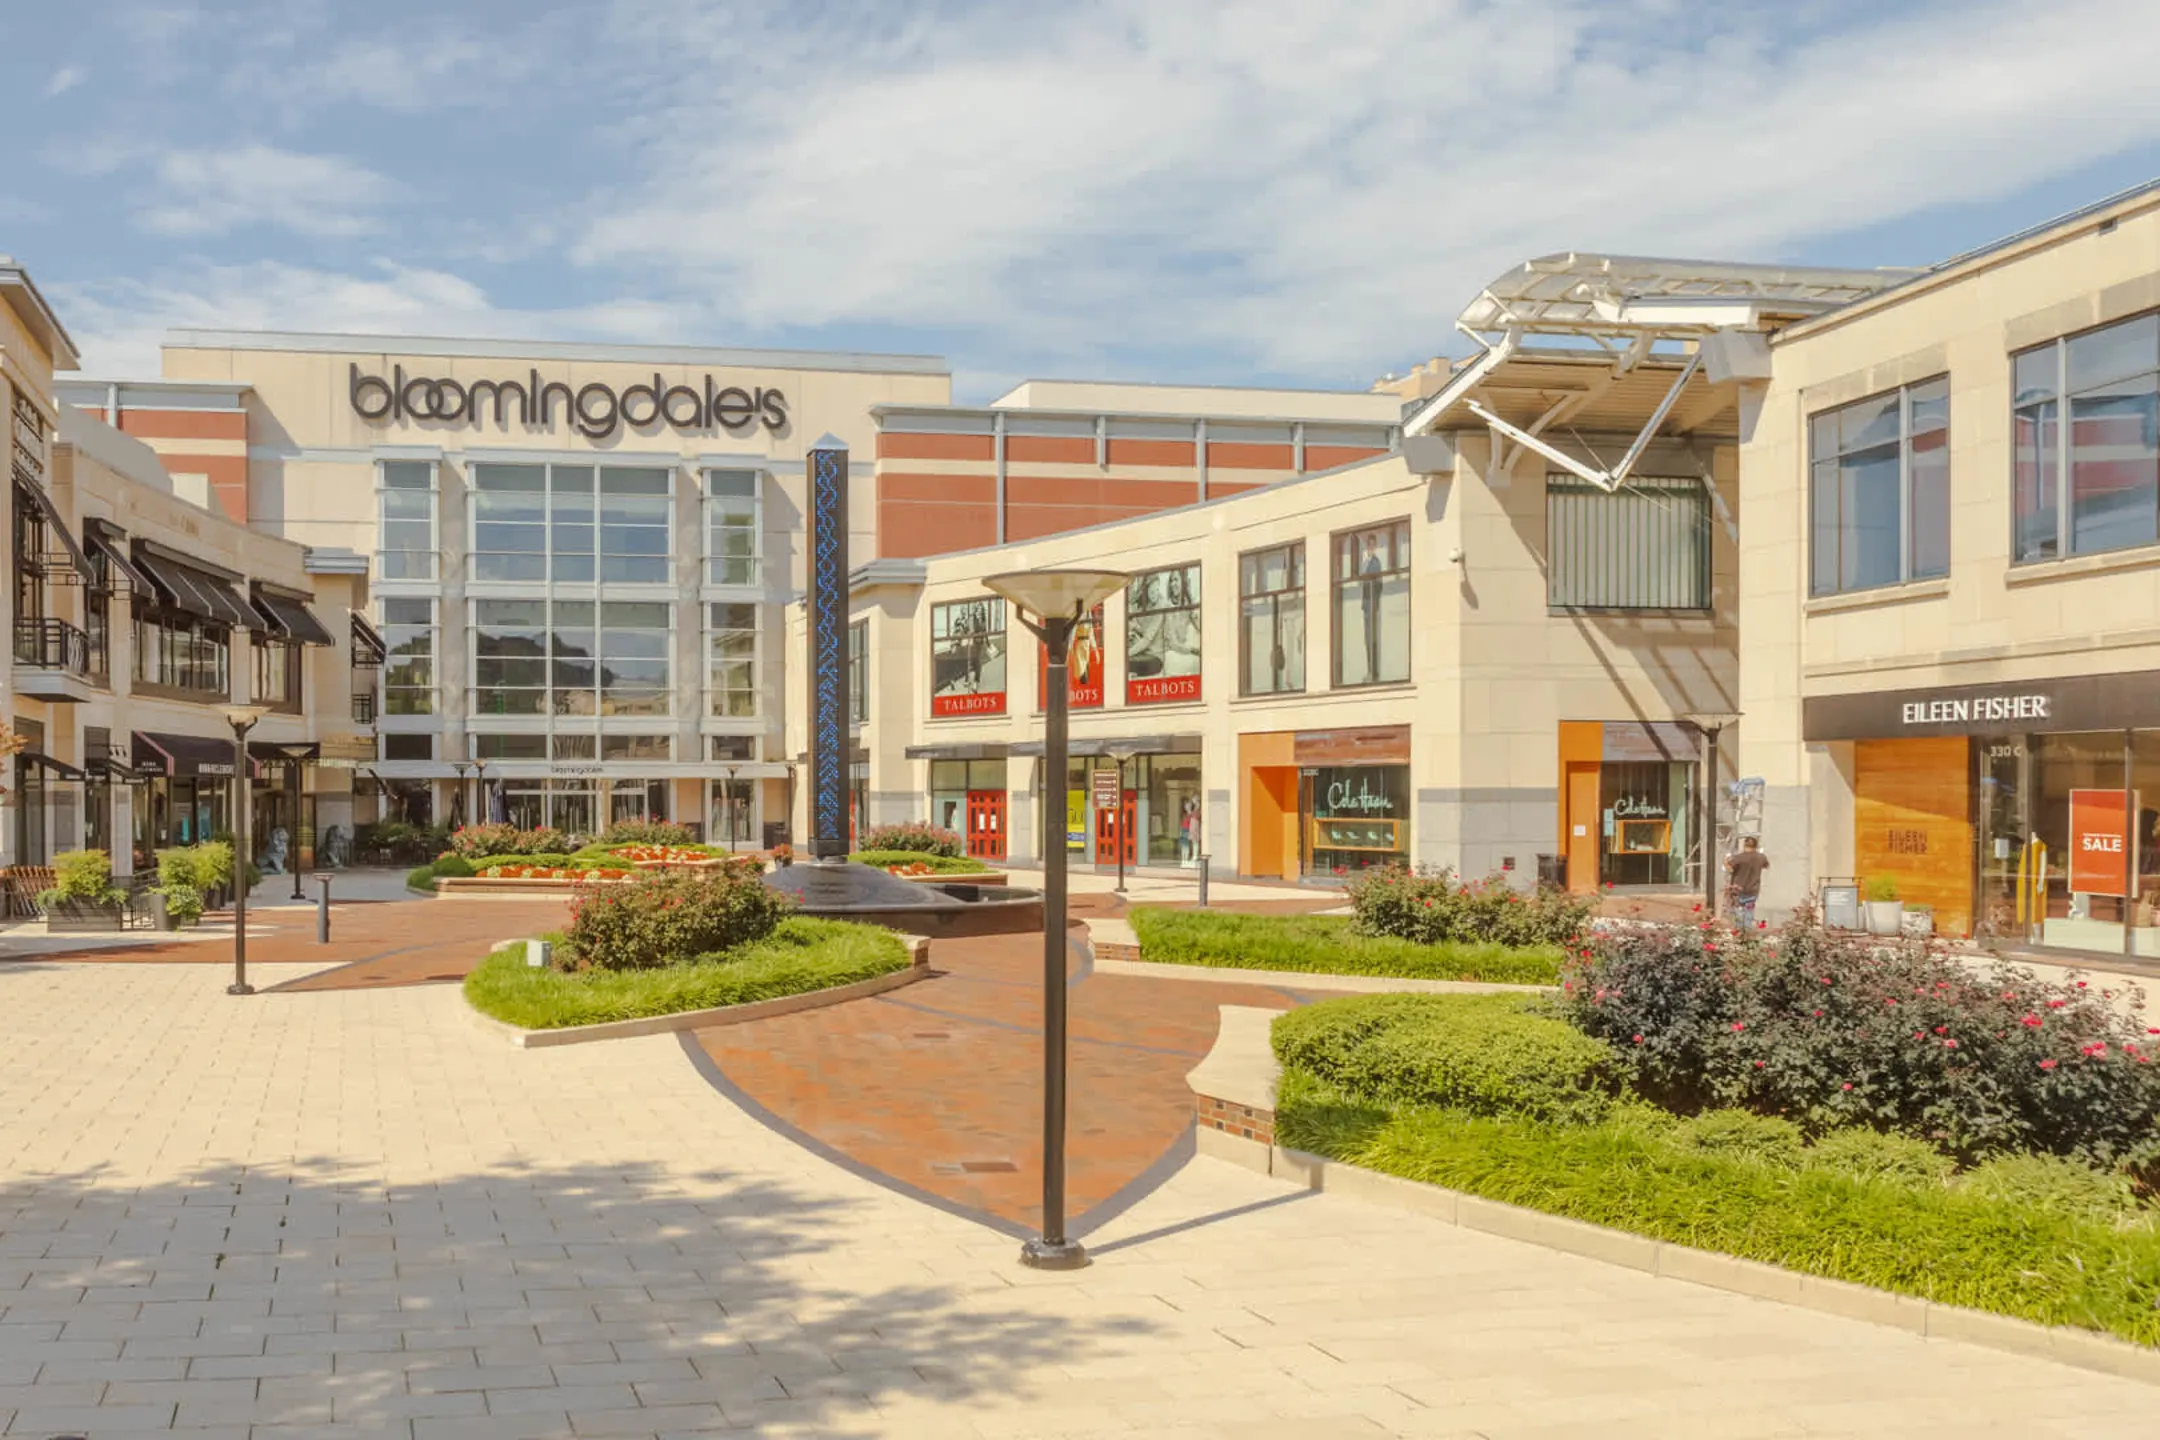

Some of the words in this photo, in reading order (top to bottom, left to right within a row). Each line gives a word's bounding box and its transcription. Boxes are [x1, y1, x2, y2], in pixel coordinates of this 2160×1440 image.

[350, 362, 787, 439] bloomingdale's
[1068, 688, 1099, 703] BOTS
[1136, 680, 1195, 697] TALBOTS
[944, 696, 997, 712] TALBOTS
[1903, 700, 1968, 724] EILEEN
[1973, 695, 2048, 720] FISHER
[2082, 837, 2122, 852] SALE
